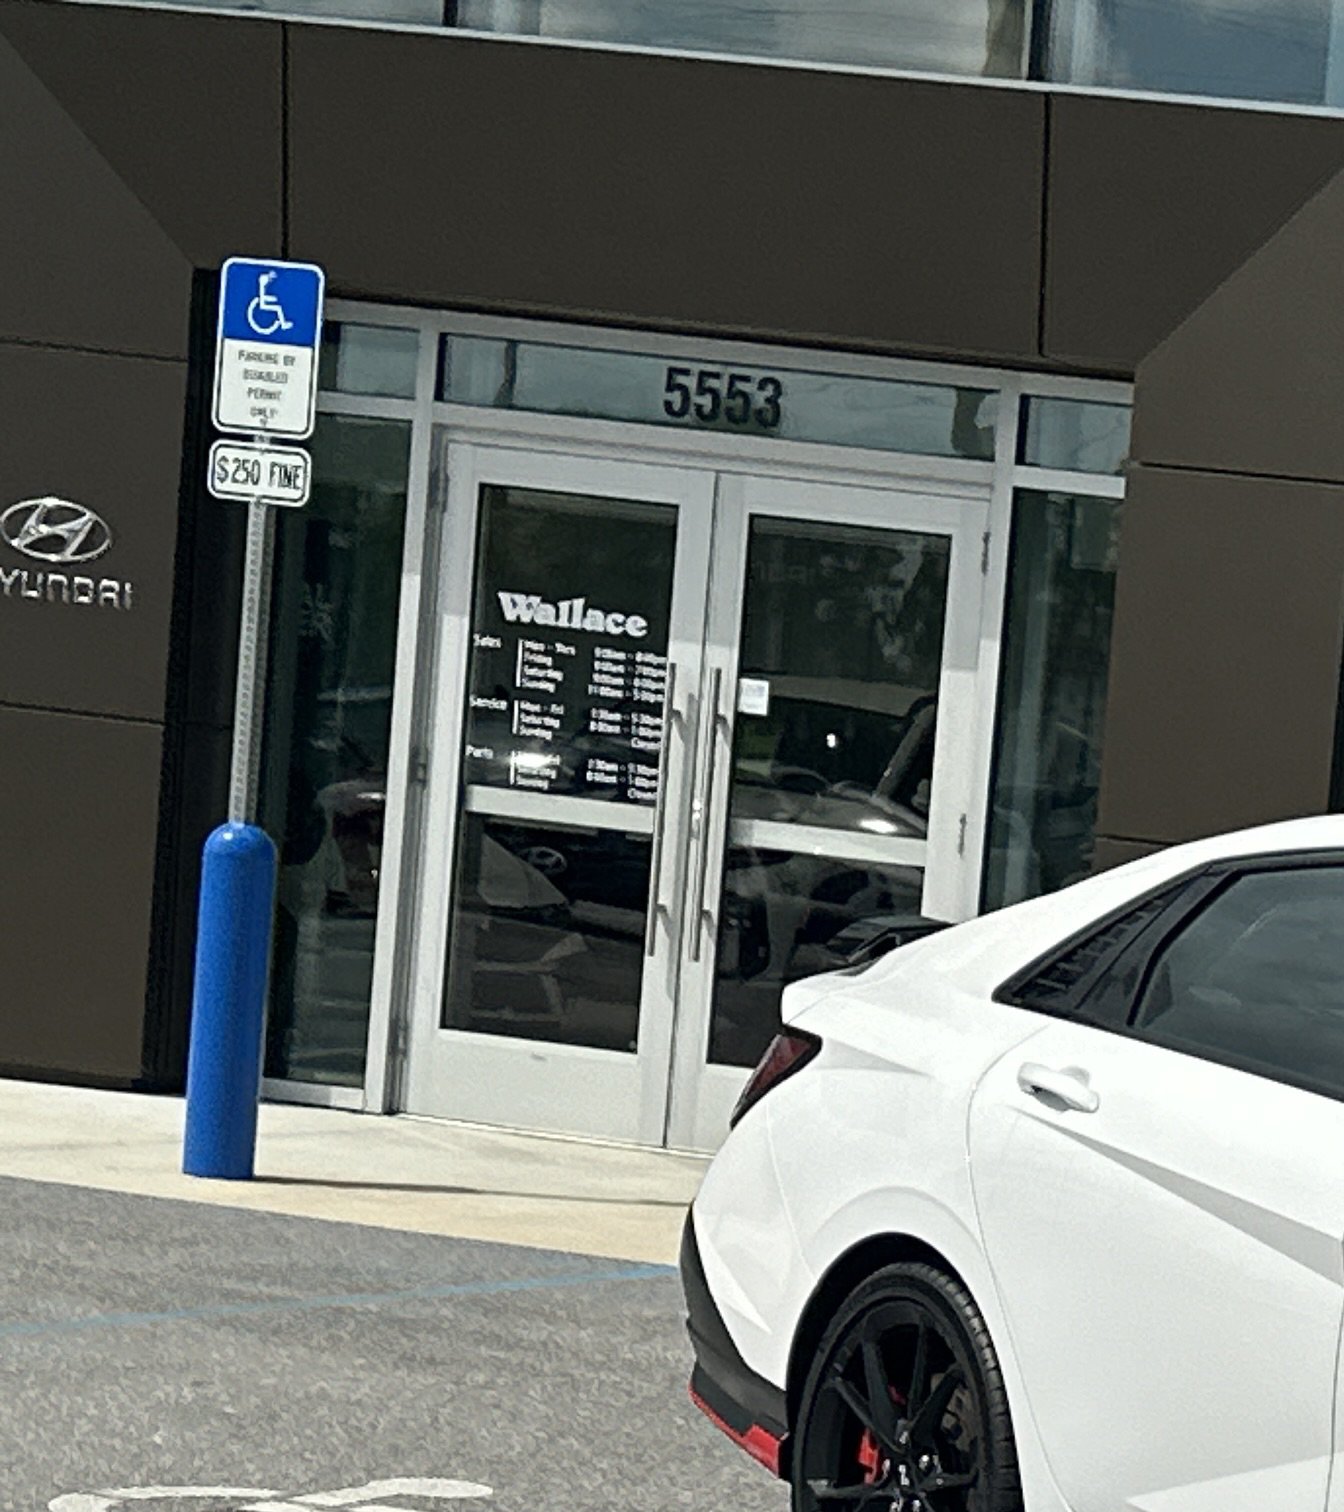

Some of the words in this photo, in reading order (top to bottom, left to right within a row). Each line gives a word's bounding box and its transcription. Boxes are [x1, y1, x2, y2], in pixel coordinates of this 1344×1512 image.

[663, 367, 782, 429] 5553
[216, 455, 261, 486] $250
[269, 461, 303, 490] FINE
[497, 591, 648, 637] Wallace
